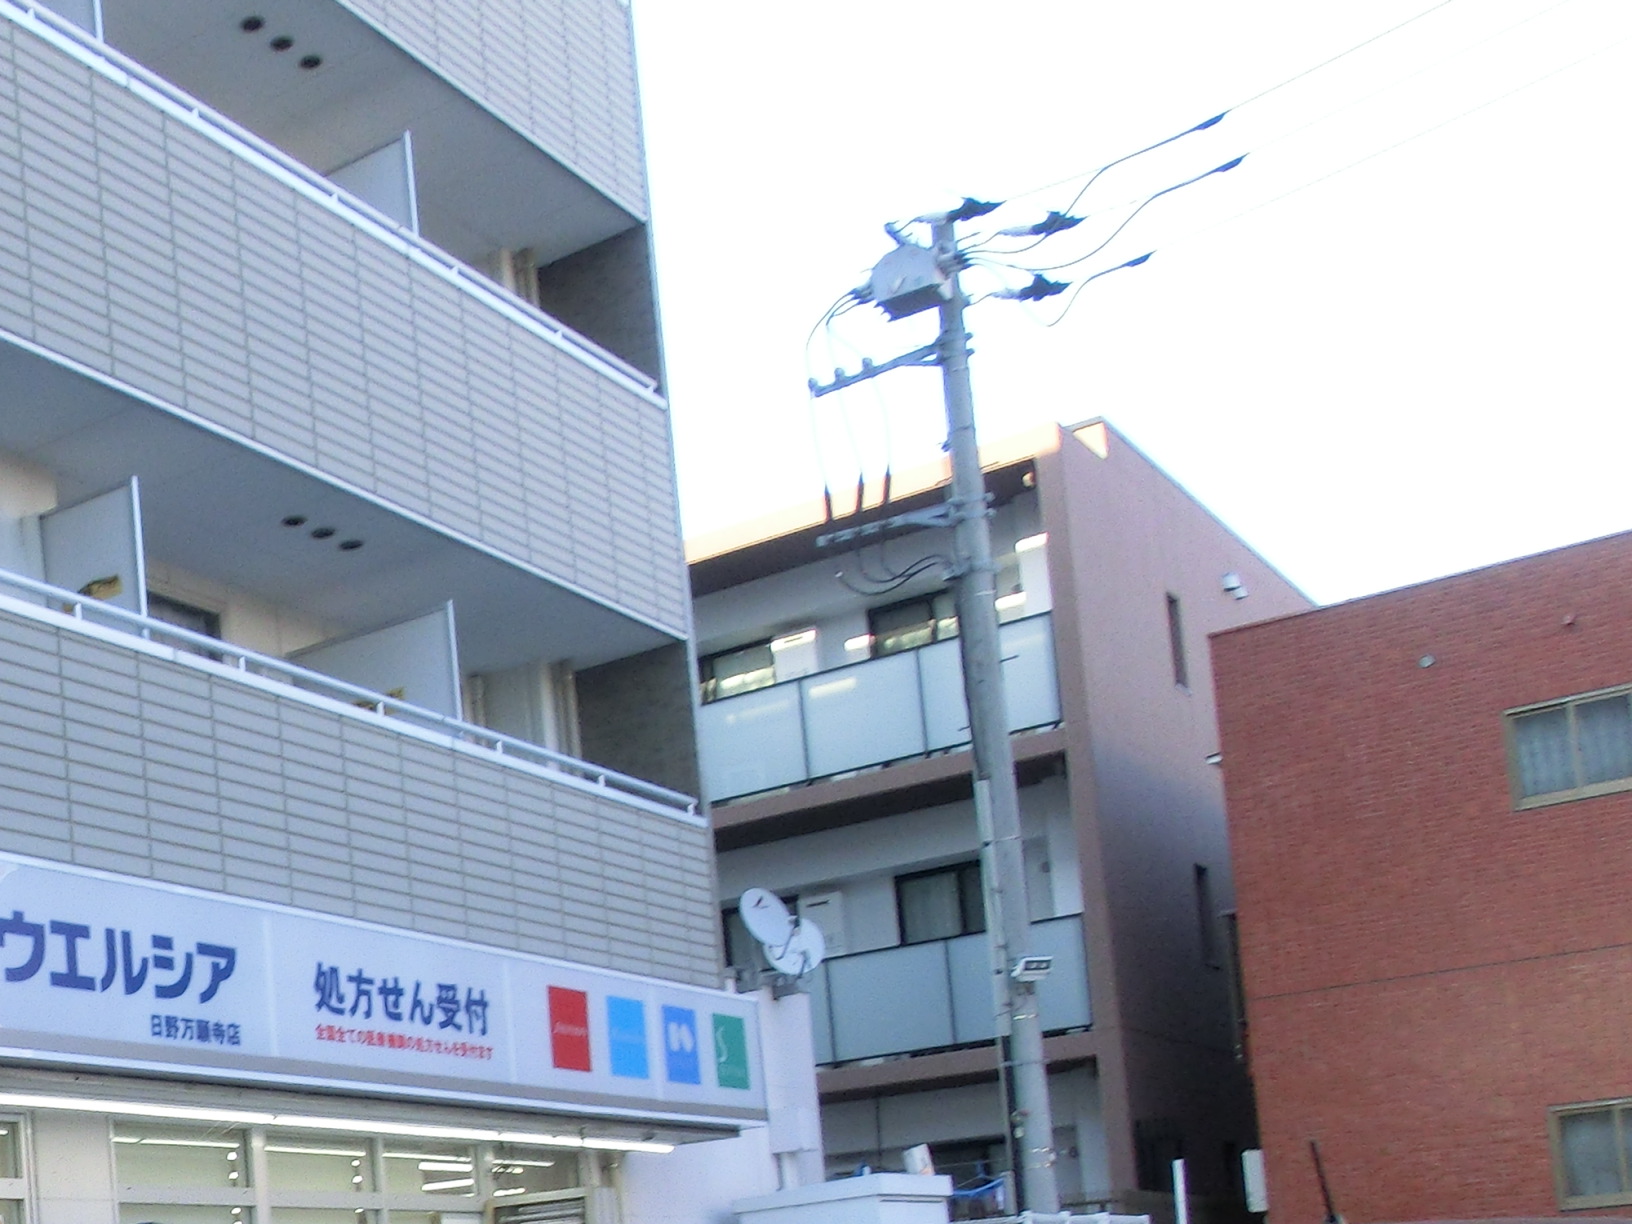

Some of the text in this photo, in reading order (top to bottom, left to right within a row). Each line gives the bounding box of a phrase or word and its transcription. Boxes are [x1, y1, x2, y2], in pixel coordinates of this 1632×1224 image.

[314, 962, 488, 1036] 処方せん受付
[150, 1014, 242, 1046] 日野万願寺店
